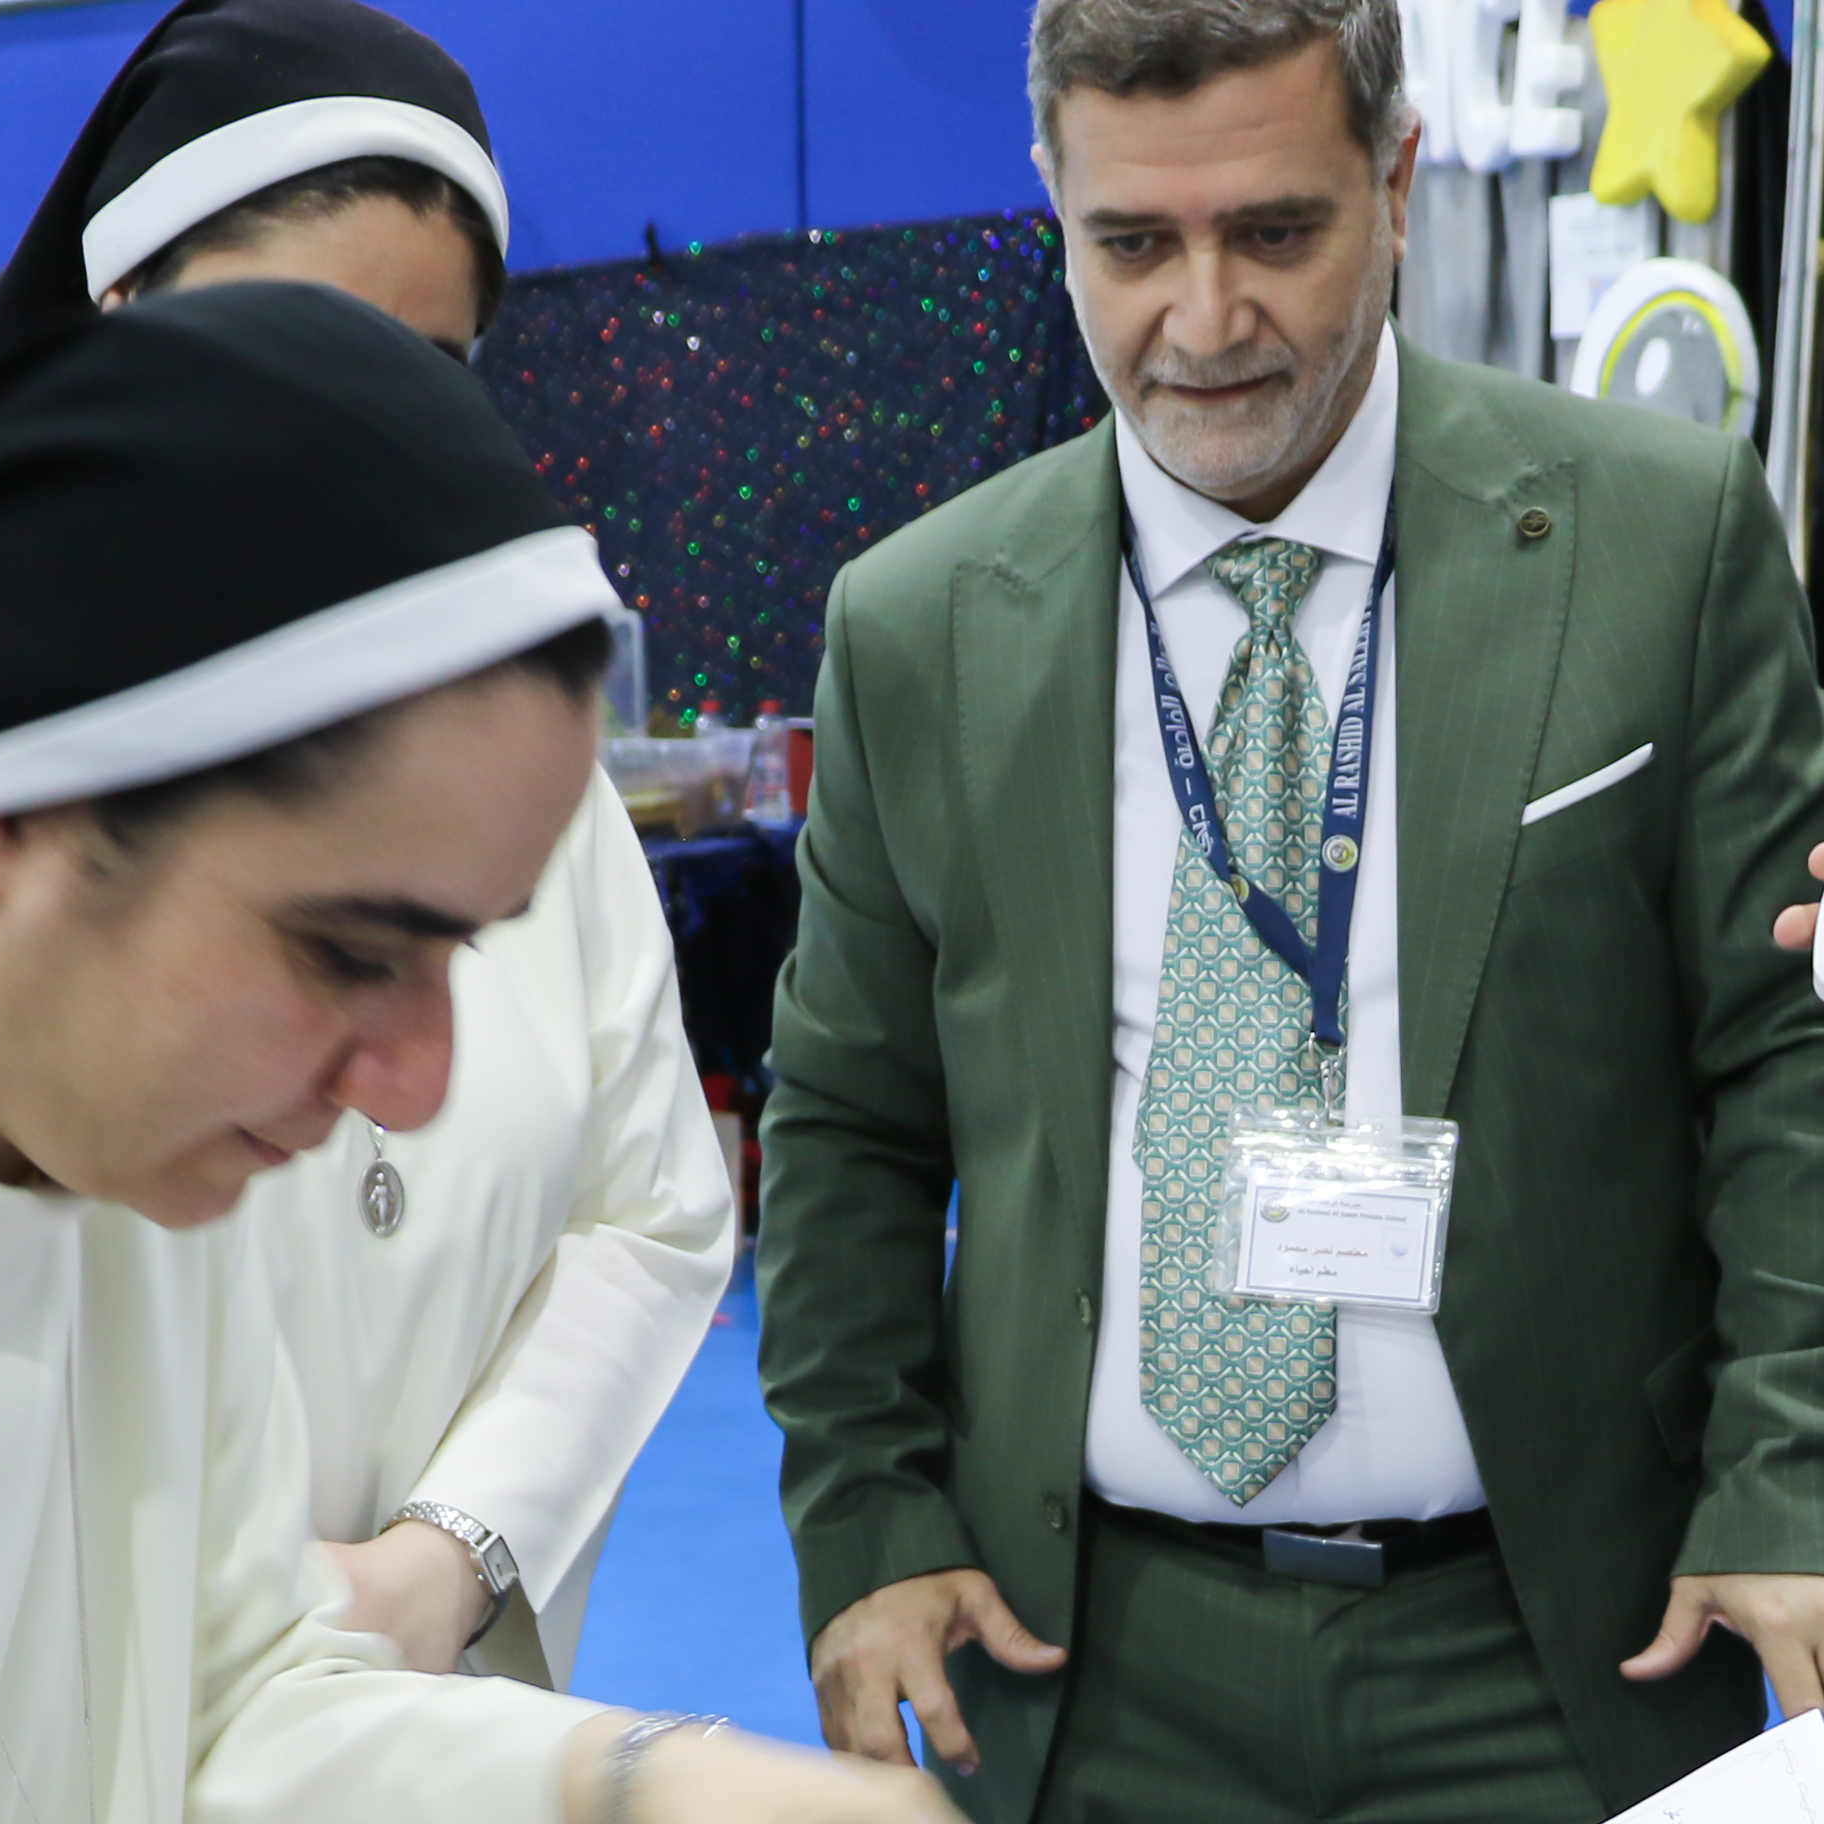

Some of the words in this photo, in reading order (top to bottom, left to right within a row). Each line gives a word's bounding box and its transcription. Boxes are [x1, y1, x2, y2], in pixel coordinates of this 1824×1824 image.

[1343, 686, 1366, 713] AL
[1334, 716, 1365, 790] RASHID
[1332, 792, 1360, 819] AL
